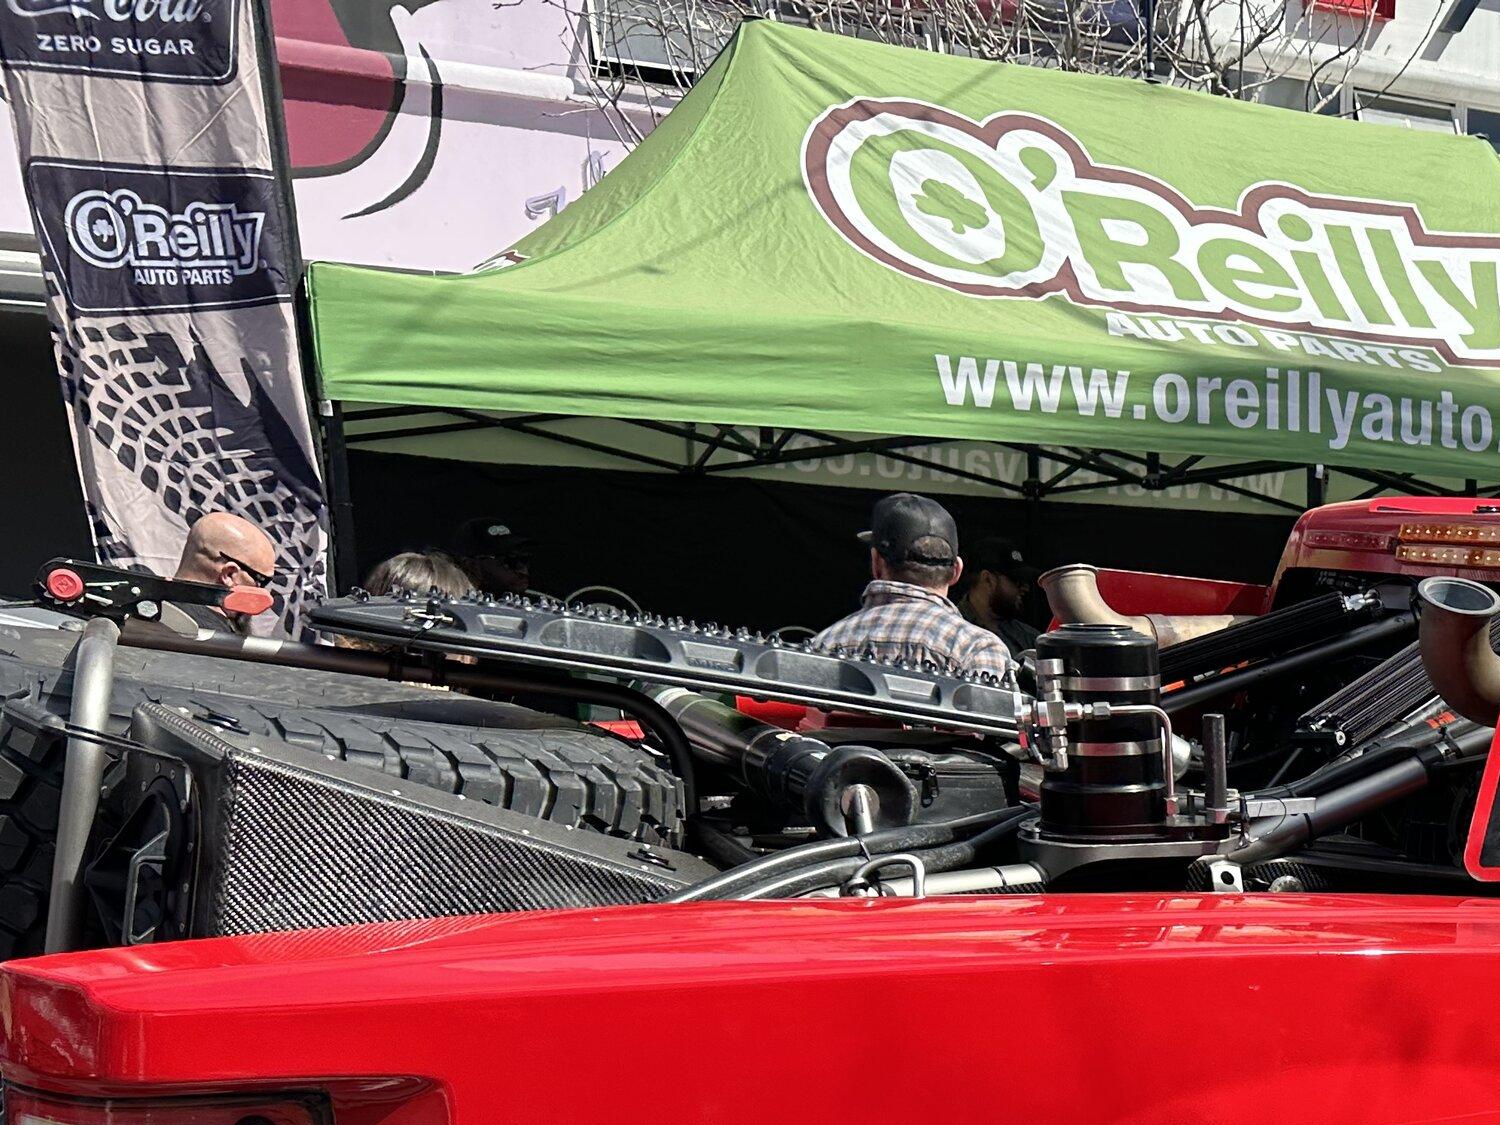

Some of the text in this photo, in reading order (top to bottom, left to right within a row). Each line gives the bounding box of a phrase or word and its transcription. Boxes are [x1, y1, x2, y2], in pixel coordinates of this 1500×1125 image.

[36, 33, 195, 55] ZERO SUGAR
[71, 195, 258, 268] O'Reilly
[135, 268, 234, 285] AUTO PARTS
[1107, 312, 1443, 374] AUTO PARTS
